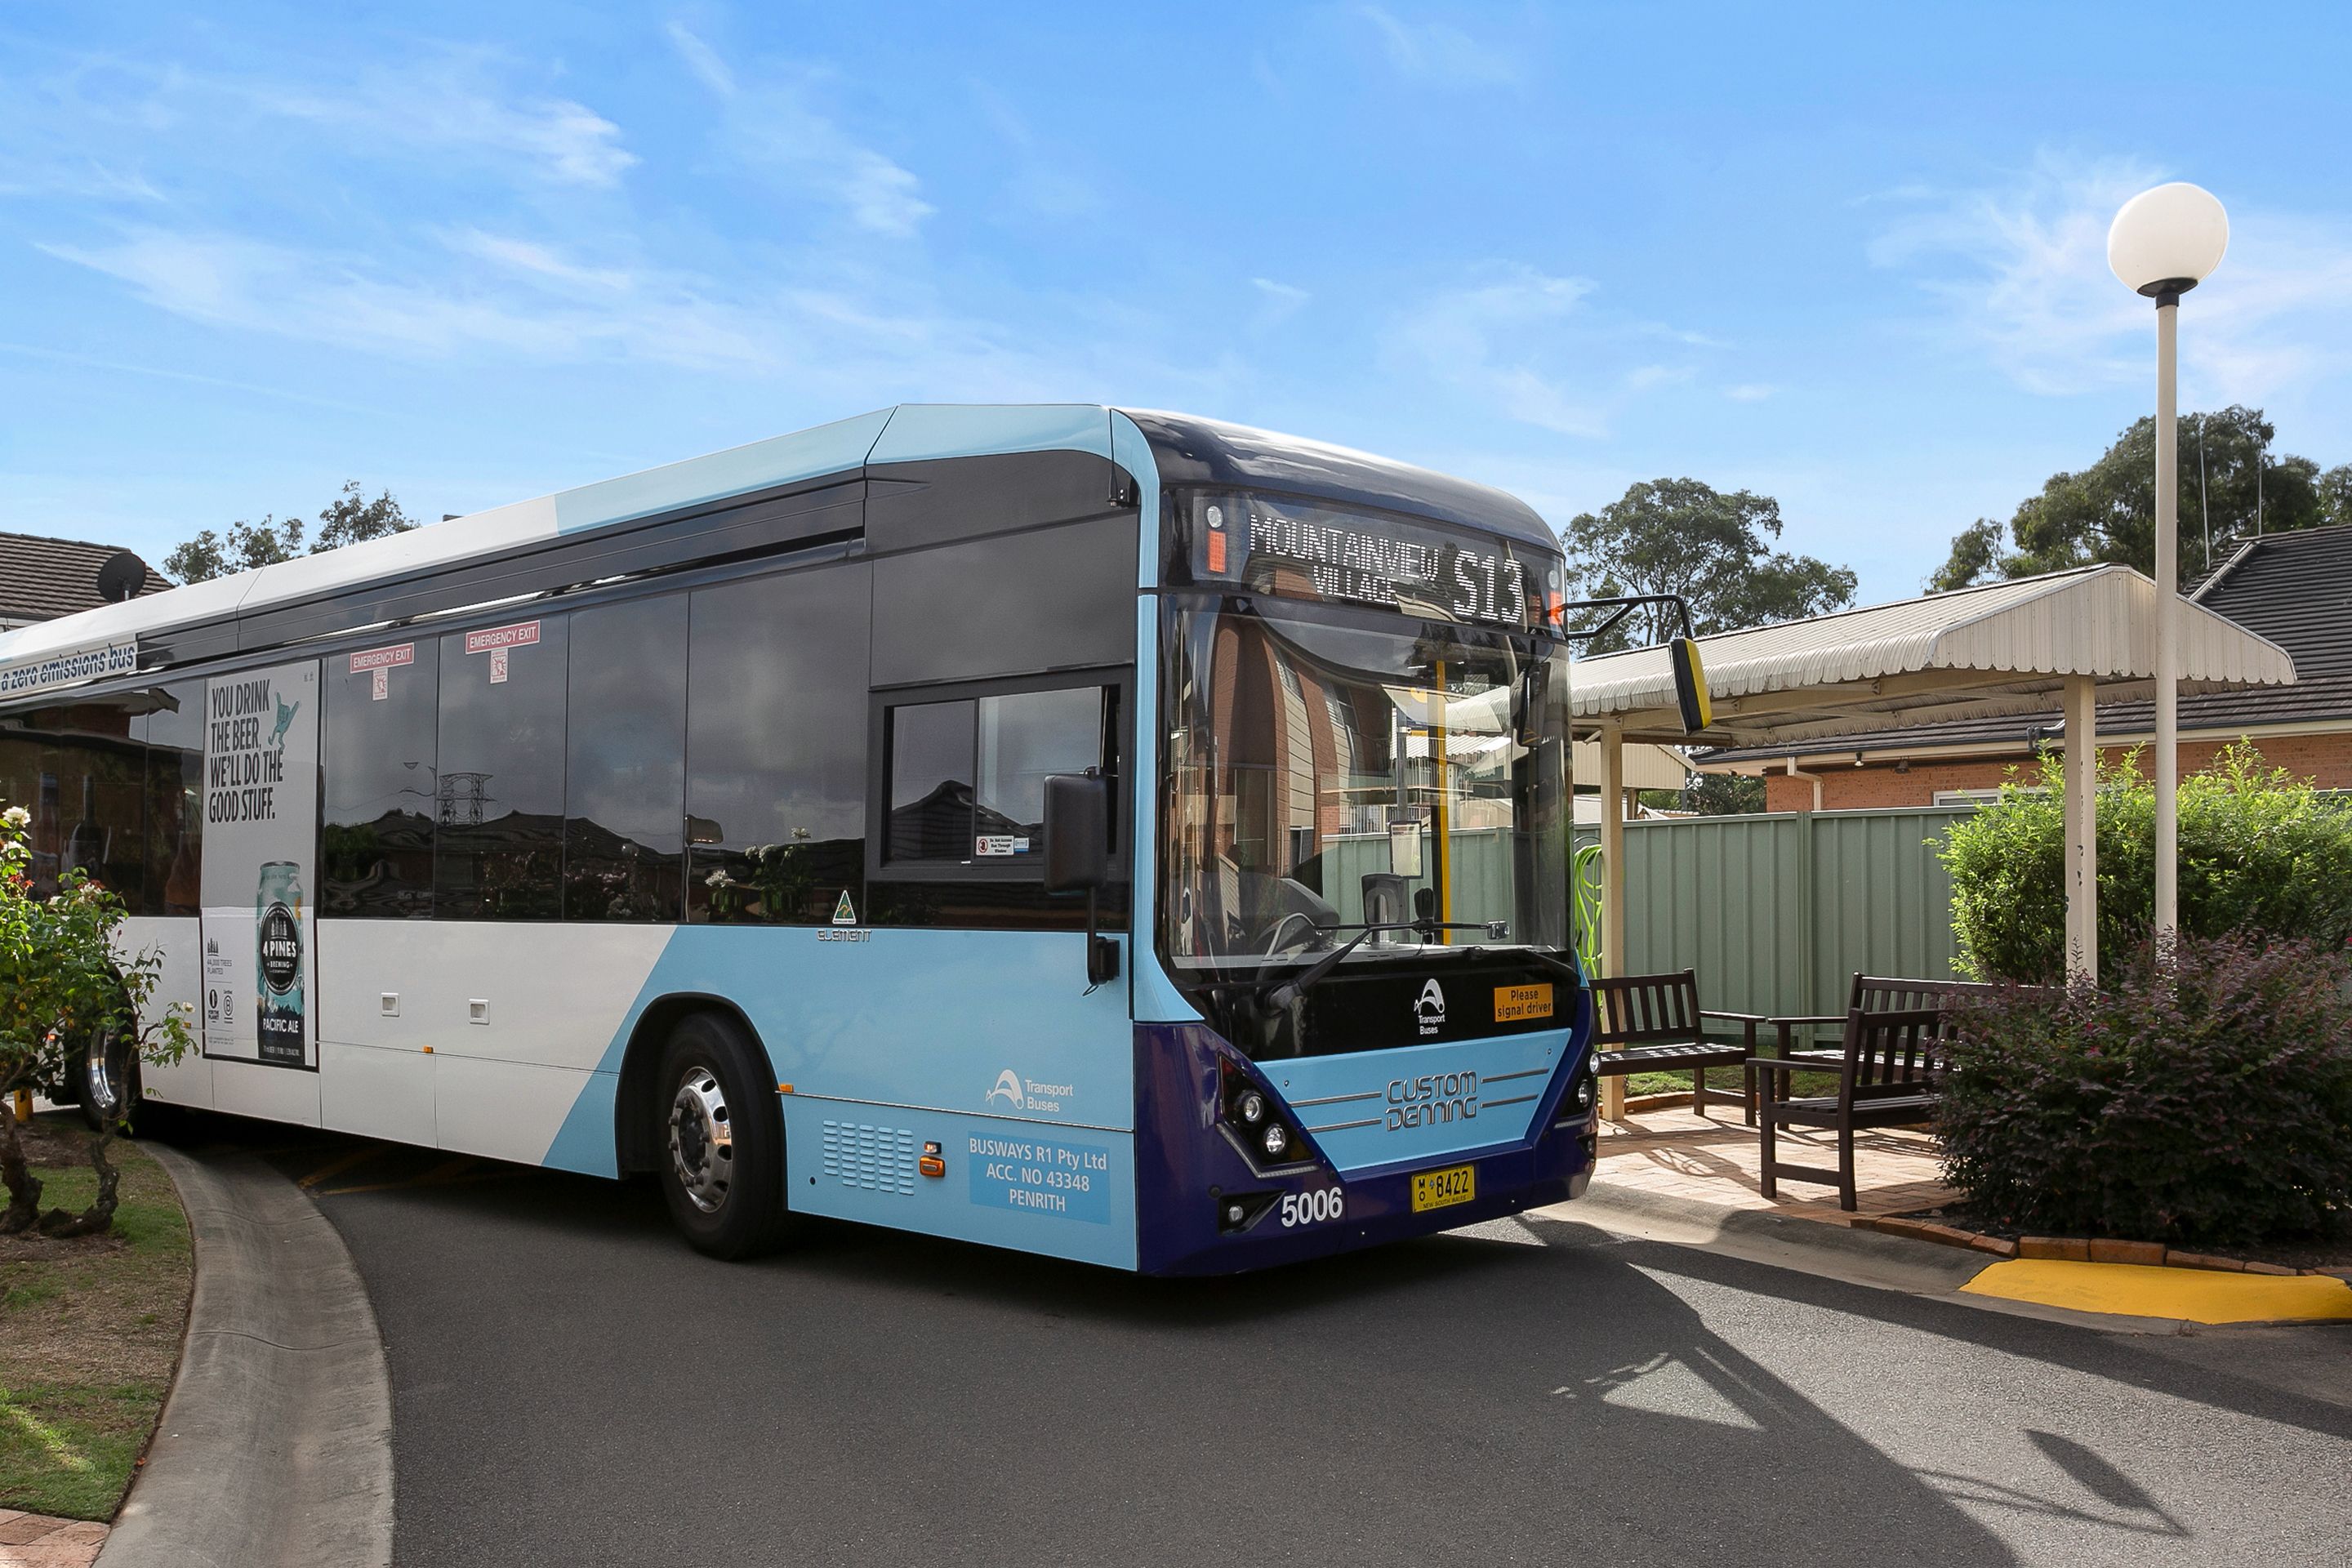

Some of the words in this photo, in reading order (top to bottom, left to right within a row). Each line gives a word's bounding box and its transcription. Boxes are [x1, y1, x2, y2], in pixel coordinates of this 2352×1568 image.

[1250, 514, 1439, 581] MOUNTAINVIEW
[1454, 550, 1522, 623] S13
[1313, 565, 1397, 605] VILLAGE
[470, 630, 518, 648] EMERGENCY
[519, 626, 537, 639] EXIT
[2, 672, 8, 691] a
[11, 666, 38, 689] zero
[40, 651, 106, 684] emissions
[108, 643, 136, 670] bus
[354, 651, 394, 668] EMERGENCY
[395, 648, 411, 661] EXIT
[212, 685, 234, 719] YOU
[236, 679, 270, 716] DRINK
[211, 721, 230, 754] THE
[233, 717, 261, 751] BEER,
[210, 755, 241, 788] WE'LL
[244, 752, 260, 786] DO
[263, 750, 283, 783] THE
[208, 791, 238, 823] GOOD
[242, 786, 275, 822] STUFF.
[817, 929, 872, 942] ELEMENT
[263, 941, 268, 956] 4
[270, 941, 296, 958] PINES
[270, 960, 290, 969] BREWING
[1511, 989, 1539, 1001] Please
[1418, 1014, 1446, 1025] Transport
[1498, 1003, 1524, 1018] signal
[1526, 1002, 1552, 1013] driver
[262, 1018, 287, 1032] PACIFIC
[287, 1020, 299, 1034] ALE
[1419, 1026, 1439, 1035] Buses
[1025, 1079, 1074, 1098] Transport
[1387, 1071, 1477, 1103] CUSTOM
[1027, 1096, 1060, 1112] Buses
[1385, 1096, 1477, 1131] DENNING
[969, 1138, 1032, 1160] BUSWAYS
[1036, 1147, 1052, 1163] R1
[1058, 1148, 1080, 1170] Pty
[1084, 1152, 1107, 1170] Ltd
[987, 1163, 1017, 1182] ACC.
[1022, 1167, 1042, 1185] NO
[1046, 1171, 1090, 1192] 43348
[1437, 1170, 1468, 1198] 8422
[1009, 1188, 1066, 1212] PENRITH
[1281, 1187, 1343, 1227] 5006
[1435, 1198, 1450, 1206] SOUTH
[1451, 1195, 1466, 1203] WALES
